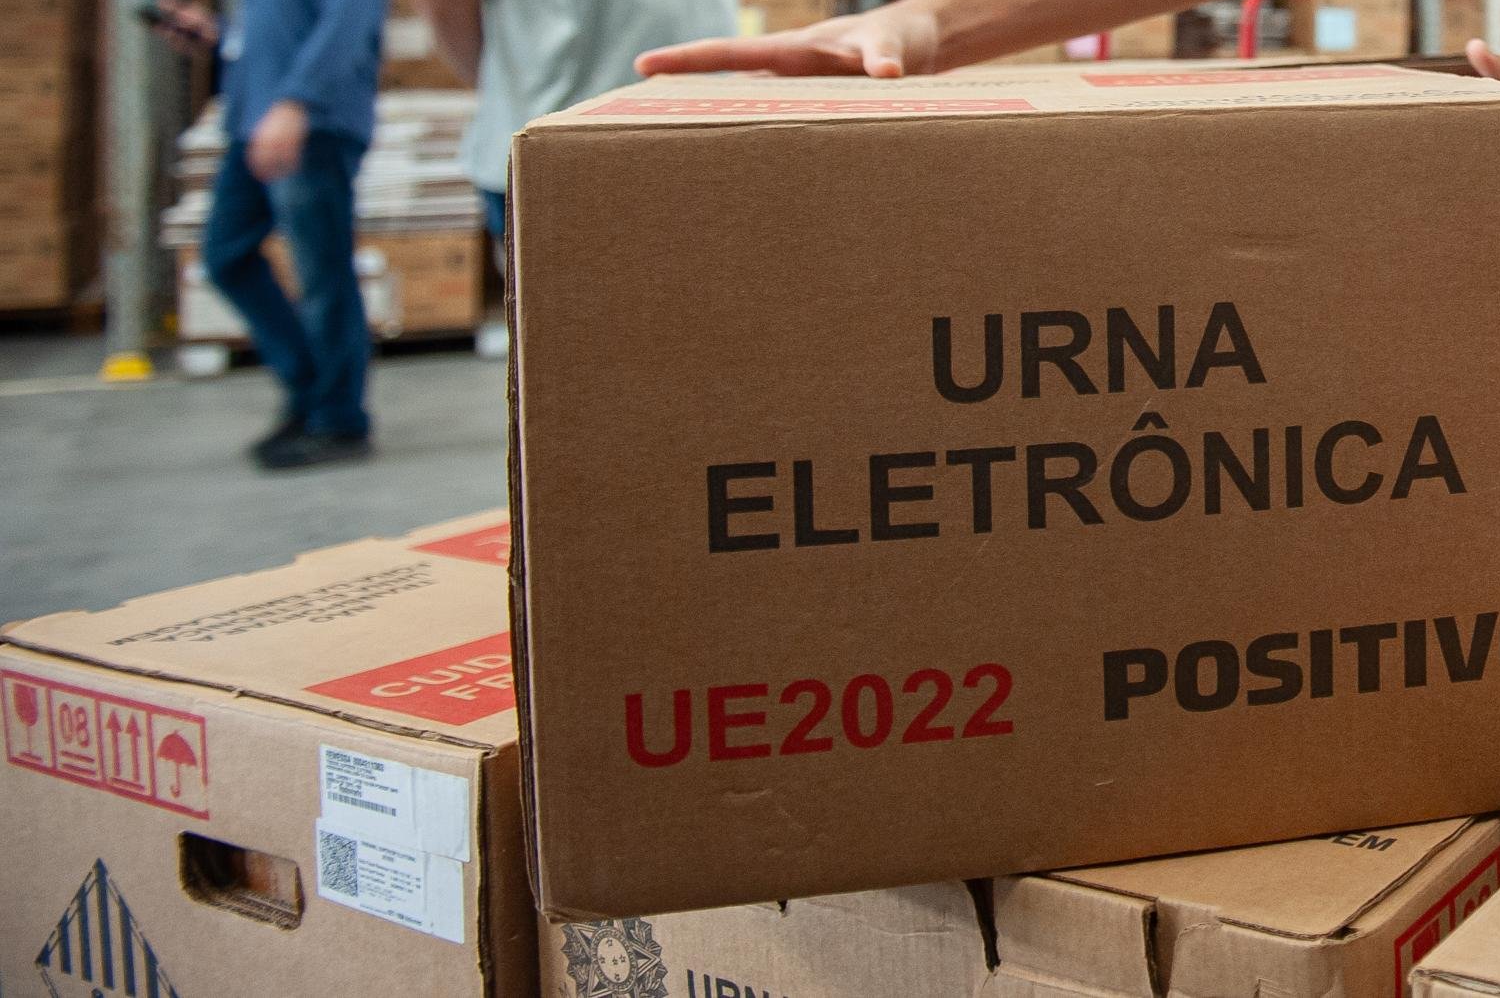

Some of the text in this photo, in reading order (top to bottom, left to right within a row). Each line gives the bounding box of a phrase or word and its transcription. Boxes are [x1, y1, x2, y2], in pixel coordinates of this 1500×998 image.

[932, 301, 1266, 403] URNA
[707, 412, 1466, 553] ELETRÔNICA
[370, 654, 511, 698] CUID
[626, 664, 1013, 766] UE2022
